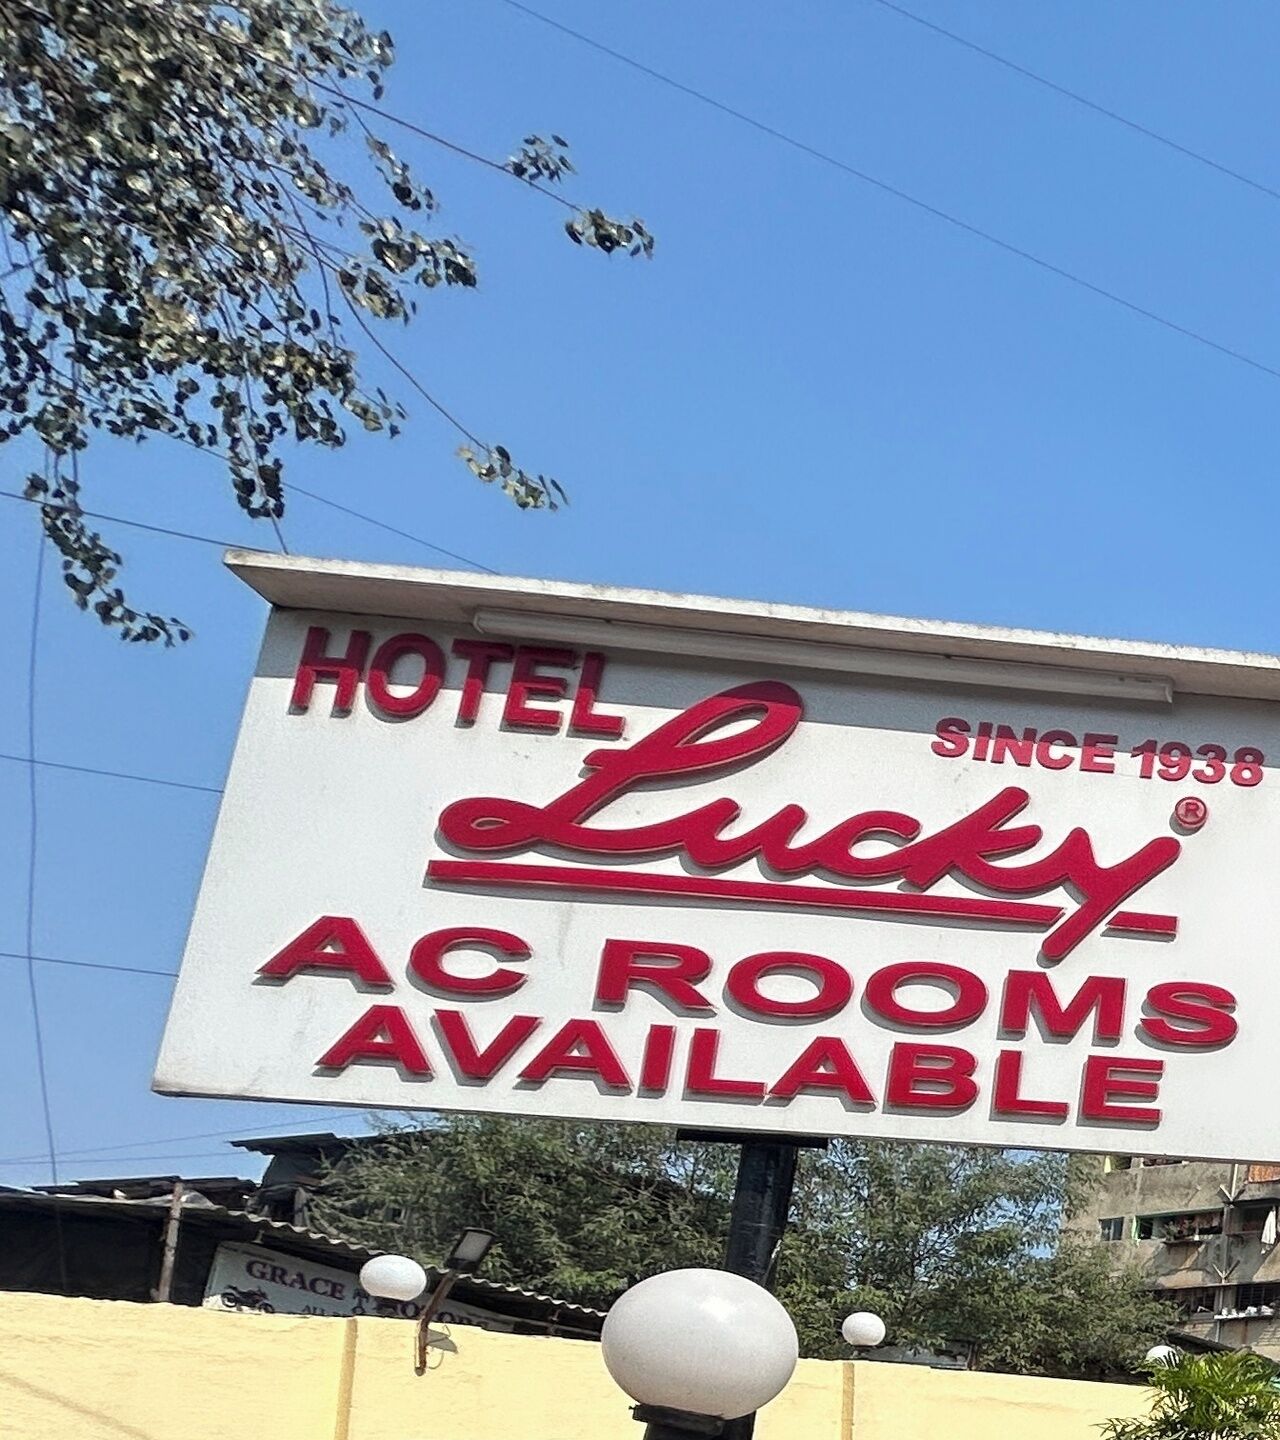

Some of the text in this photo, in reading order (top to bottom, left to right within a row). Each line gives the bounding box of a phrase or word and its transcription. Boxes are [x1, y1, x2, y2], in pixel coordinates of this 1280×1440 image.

[289, 626, 626, 740] HOTEL
[931, 717, 1266, 789] SINCE 1938
[436, 680, 1183, 962] Lucky
[254, 915, 1239, 1050] AC ROOMS
[314, 1003, 1165, 1125] AVAILABLE
[245, 1259, 346, 1300] GRACE
